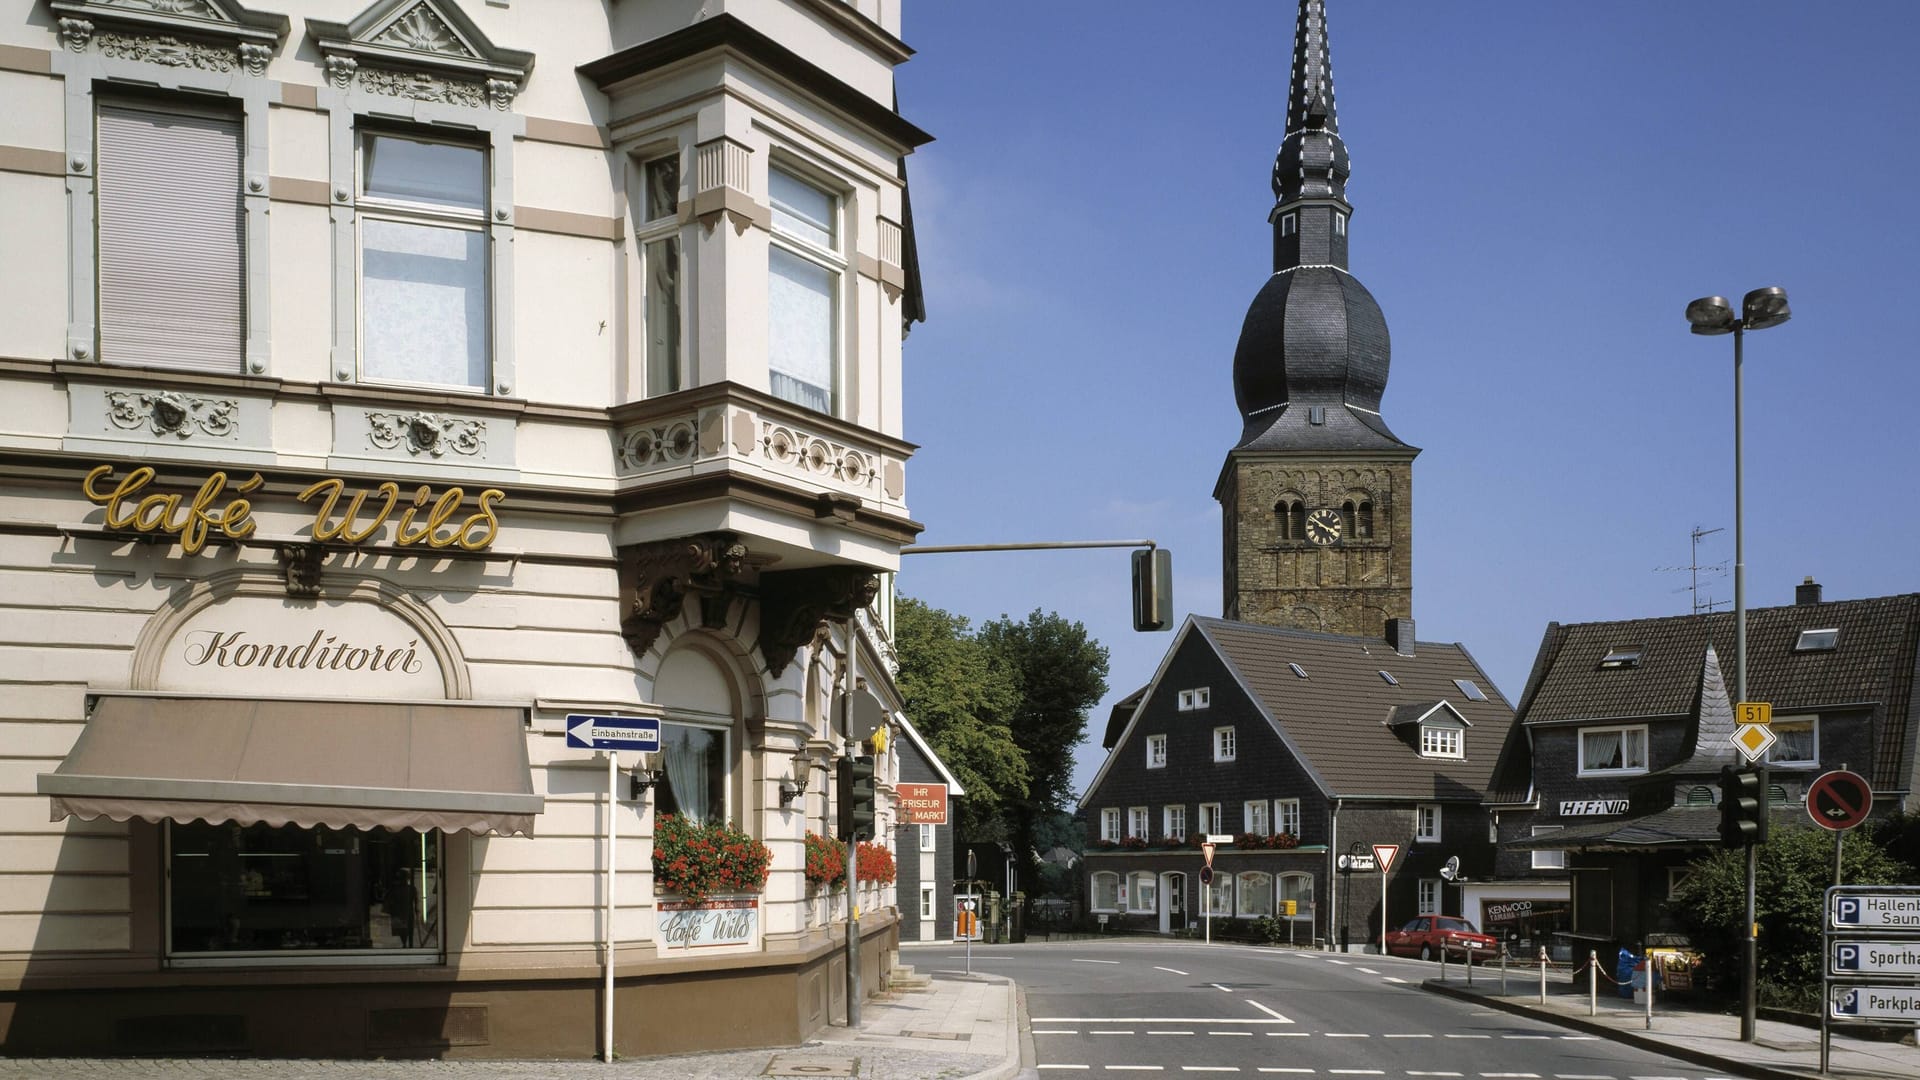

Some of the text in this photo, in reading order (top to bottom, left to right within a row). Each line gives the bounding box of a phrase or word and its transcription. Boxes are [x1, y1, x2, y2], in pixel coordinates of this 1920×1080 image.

[83, 465, 506, 555] Café Wild
[184, 629, 423, 674] Konditorei
[1745, 706, 1762, 721] 51
[591, 728, 654, 740] Einbahnstraße
[913, 788, 929, 797] IHR
[901, 799, 940, 809] FRISEUR
[1562, 801, 1601, 815] HiFi
[915, 811, 945, 820] MARKT
[1487, 901, 1532, 915] KENWOOD
[660, 910, 755, 950] Café Wild
